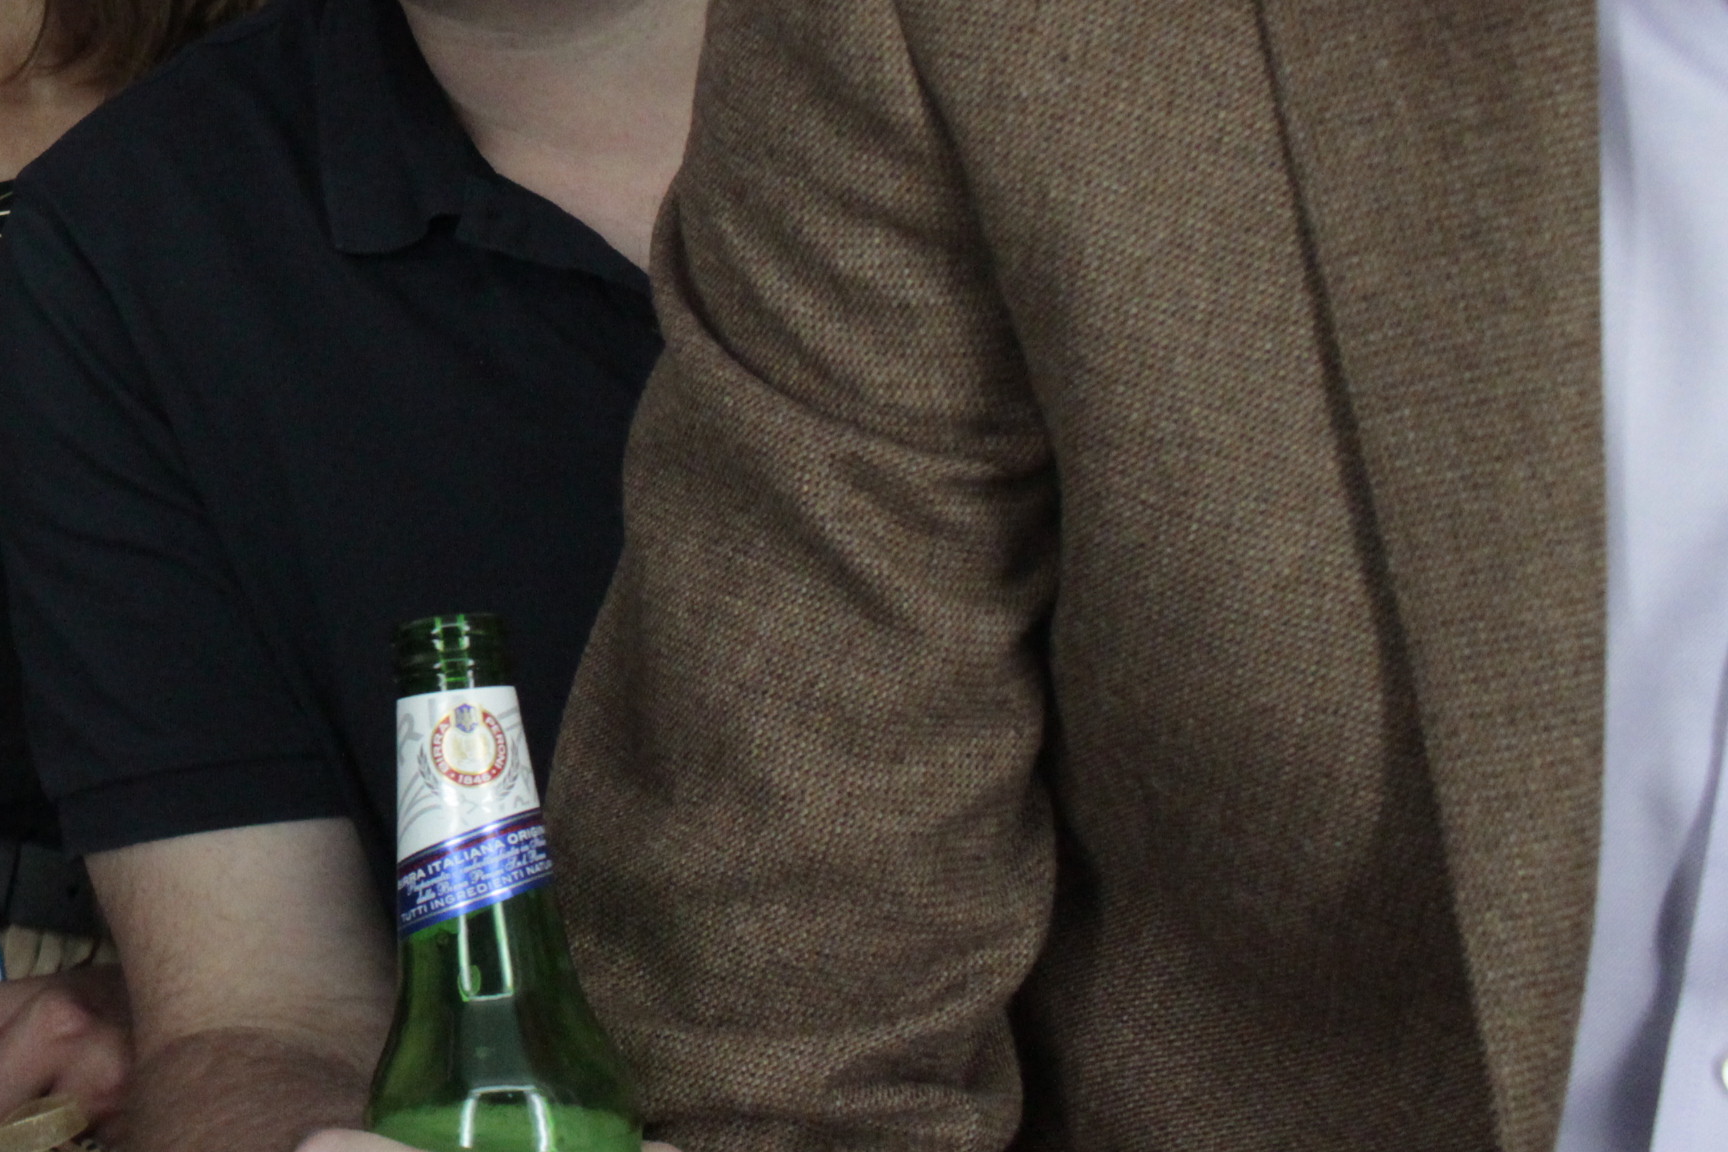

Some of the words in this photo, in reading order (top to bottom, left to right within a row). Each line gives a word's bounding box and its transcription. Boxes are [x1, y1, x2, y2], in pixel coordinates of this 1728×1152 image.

[433, 723, 451, 773] BIRRA
[484, 716, 507, 770] PERONI
[458, 772, 492, 785] 1846
[427, 839, 506, 875] ITALIANA
[400, 904, 428, 923] TUTTI
[430, 869, 524, 911] INGREDIENTI
